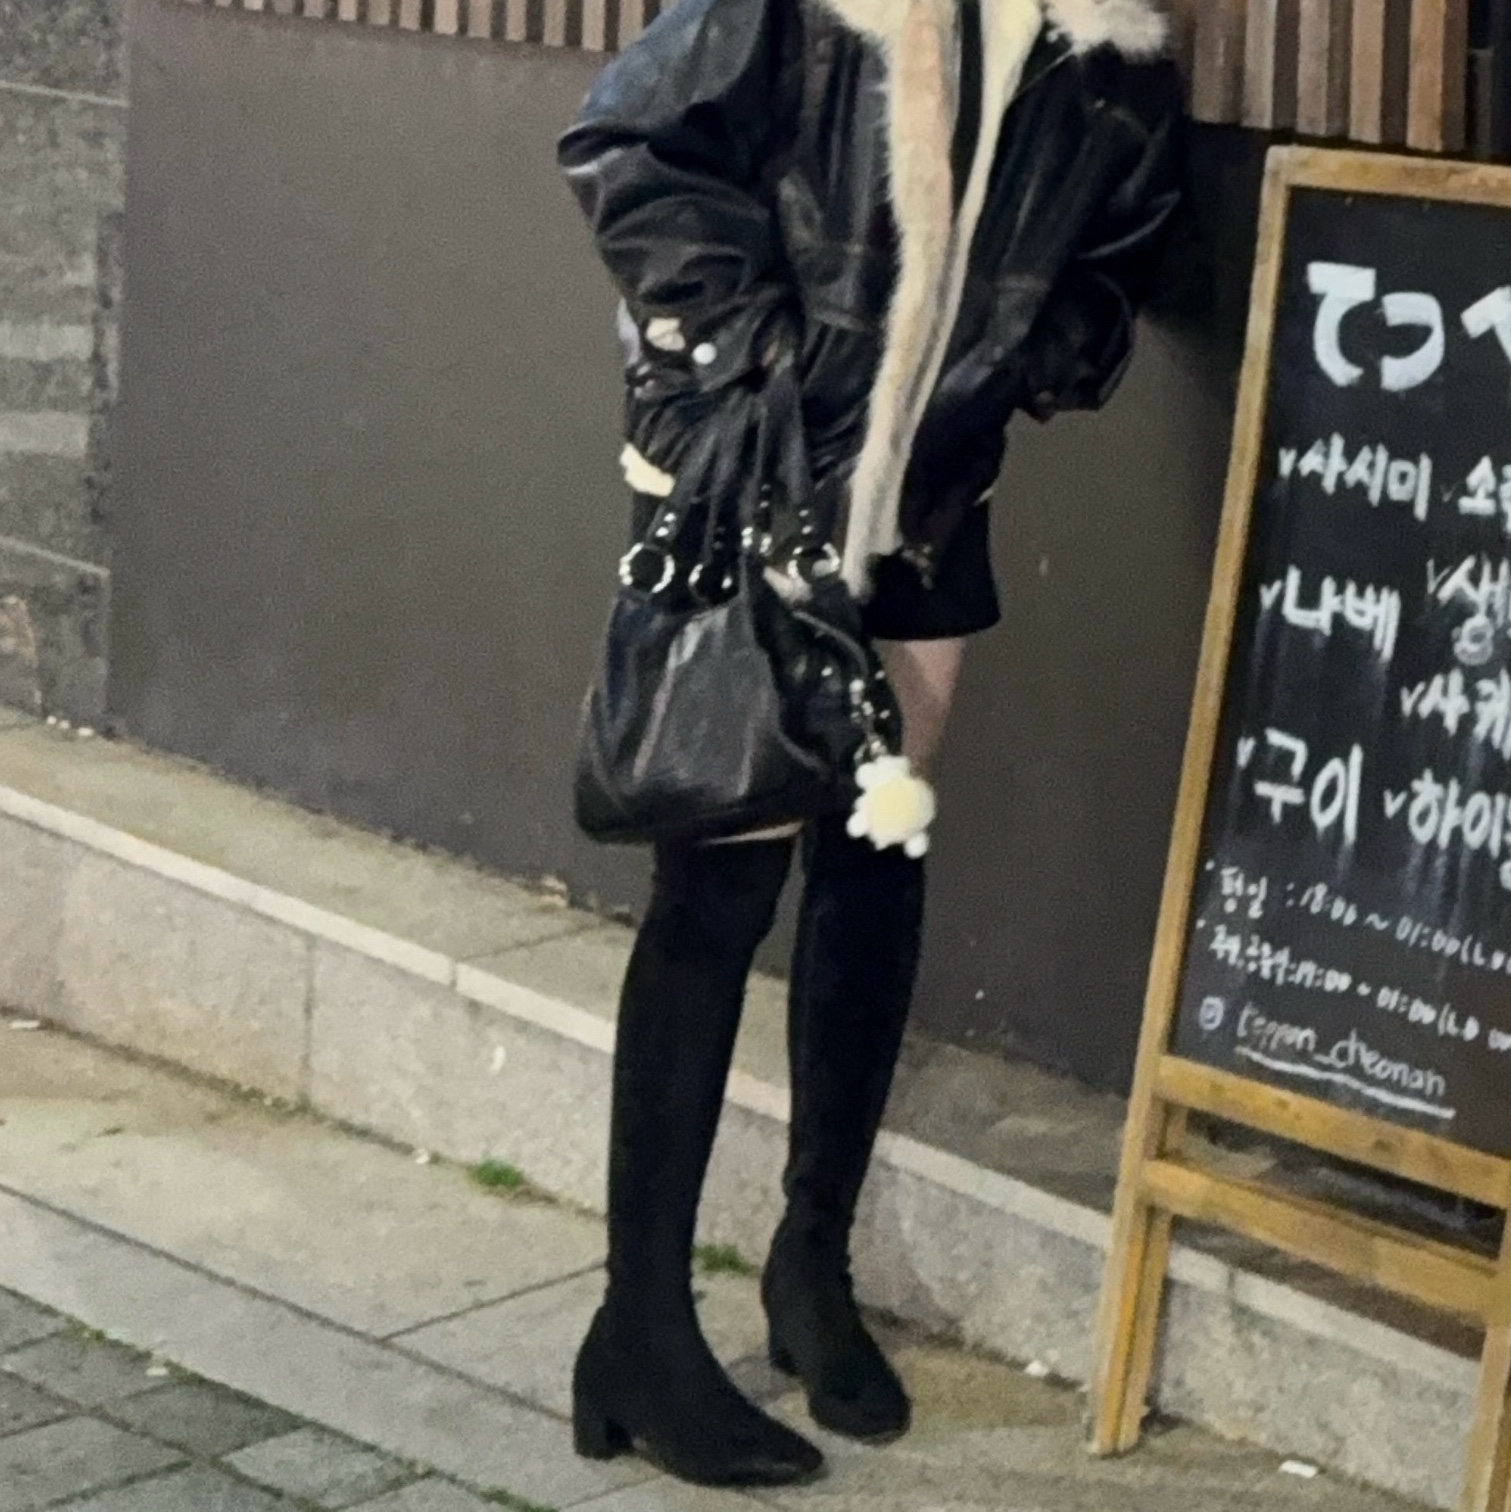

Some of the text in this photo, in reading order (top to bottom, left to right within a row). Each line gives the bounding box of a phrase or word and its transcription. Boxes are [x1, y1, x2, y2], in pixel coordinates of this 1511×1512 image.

[1300, 432, 1432, 521] 사시미
[1282, 565, 1401, 662] 나베
[1254, 728, 1363, 846] 구이
